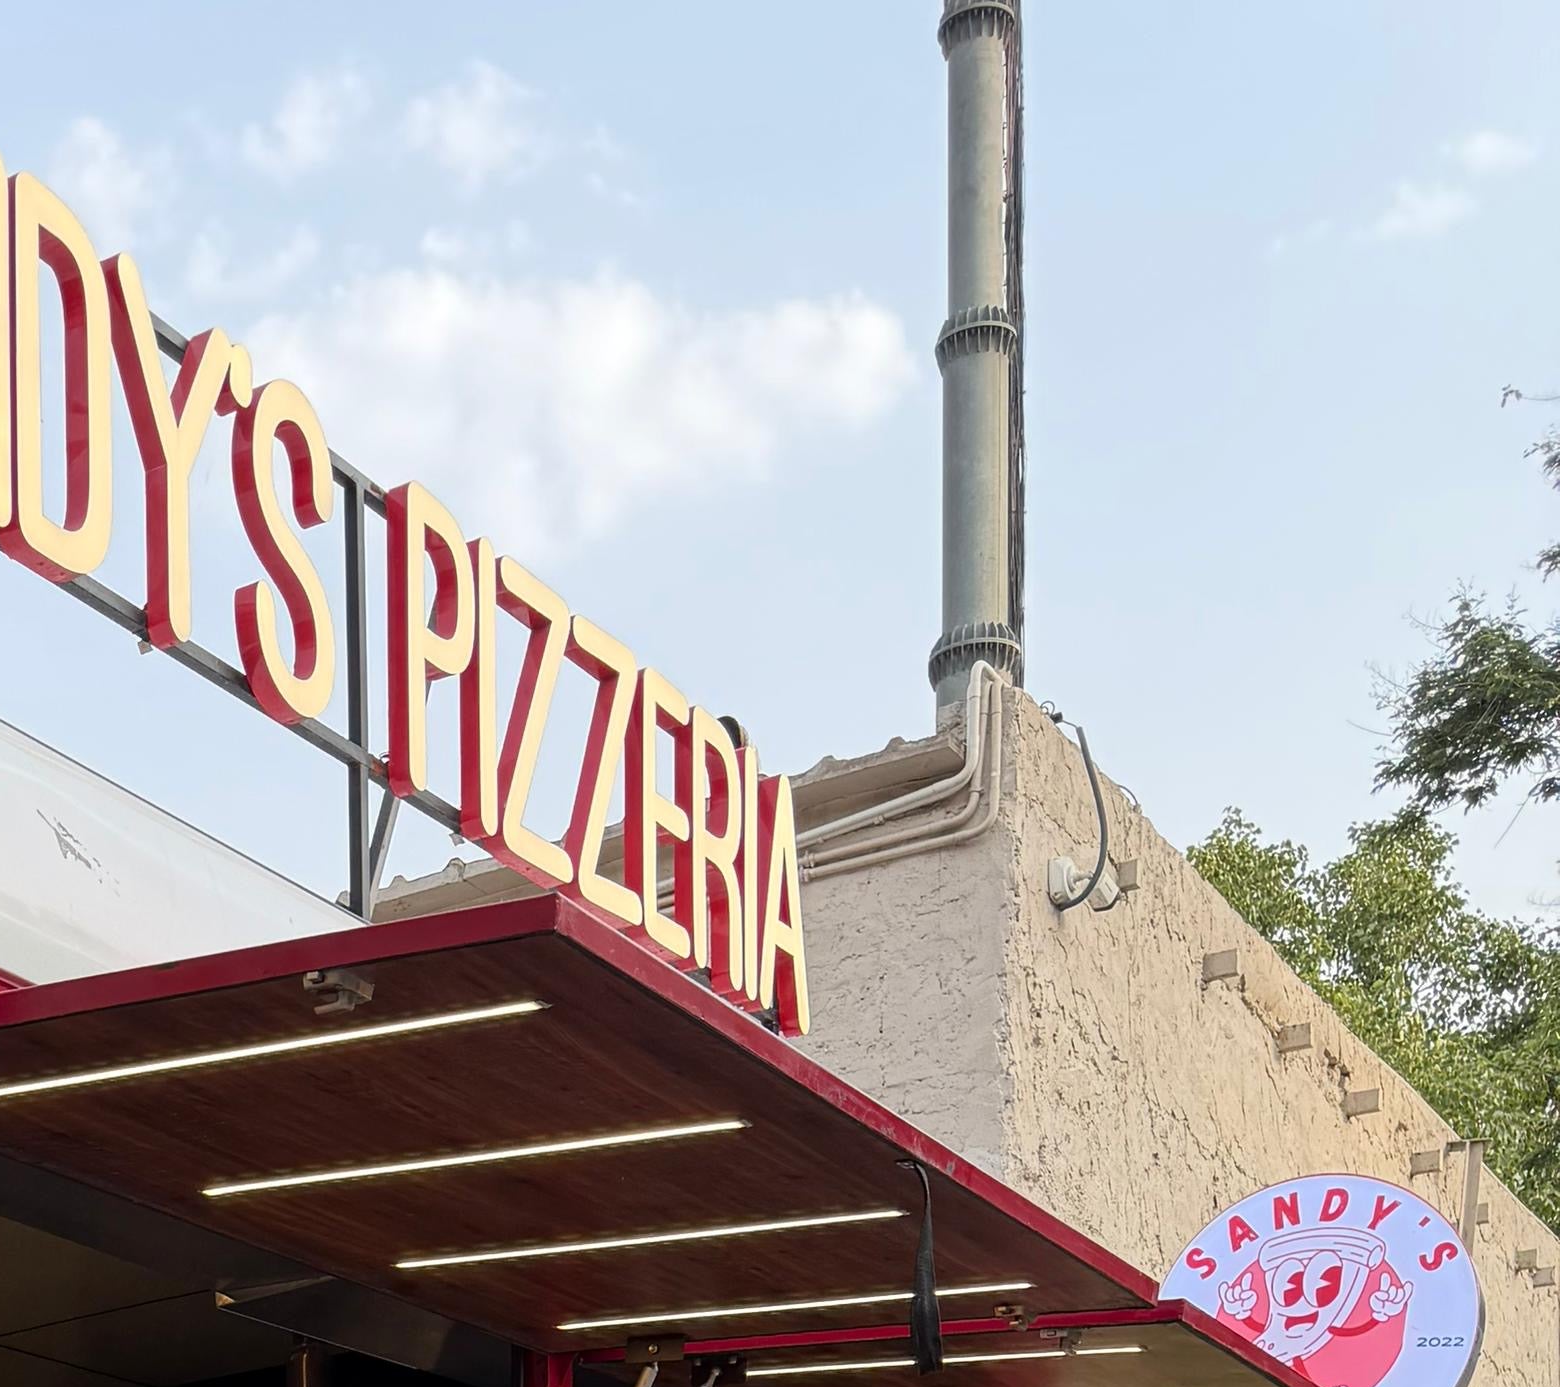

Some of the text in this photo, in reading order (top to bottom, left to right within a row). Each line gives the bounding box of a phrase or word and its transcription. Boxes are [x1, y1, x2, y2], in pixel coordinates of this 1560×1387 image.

[387, 480, 811, 1037] PIZZERIA
[1185, 1187, 1459, 1280] SANDY'S
[1416, 1336, 1465, 1348] 2022
